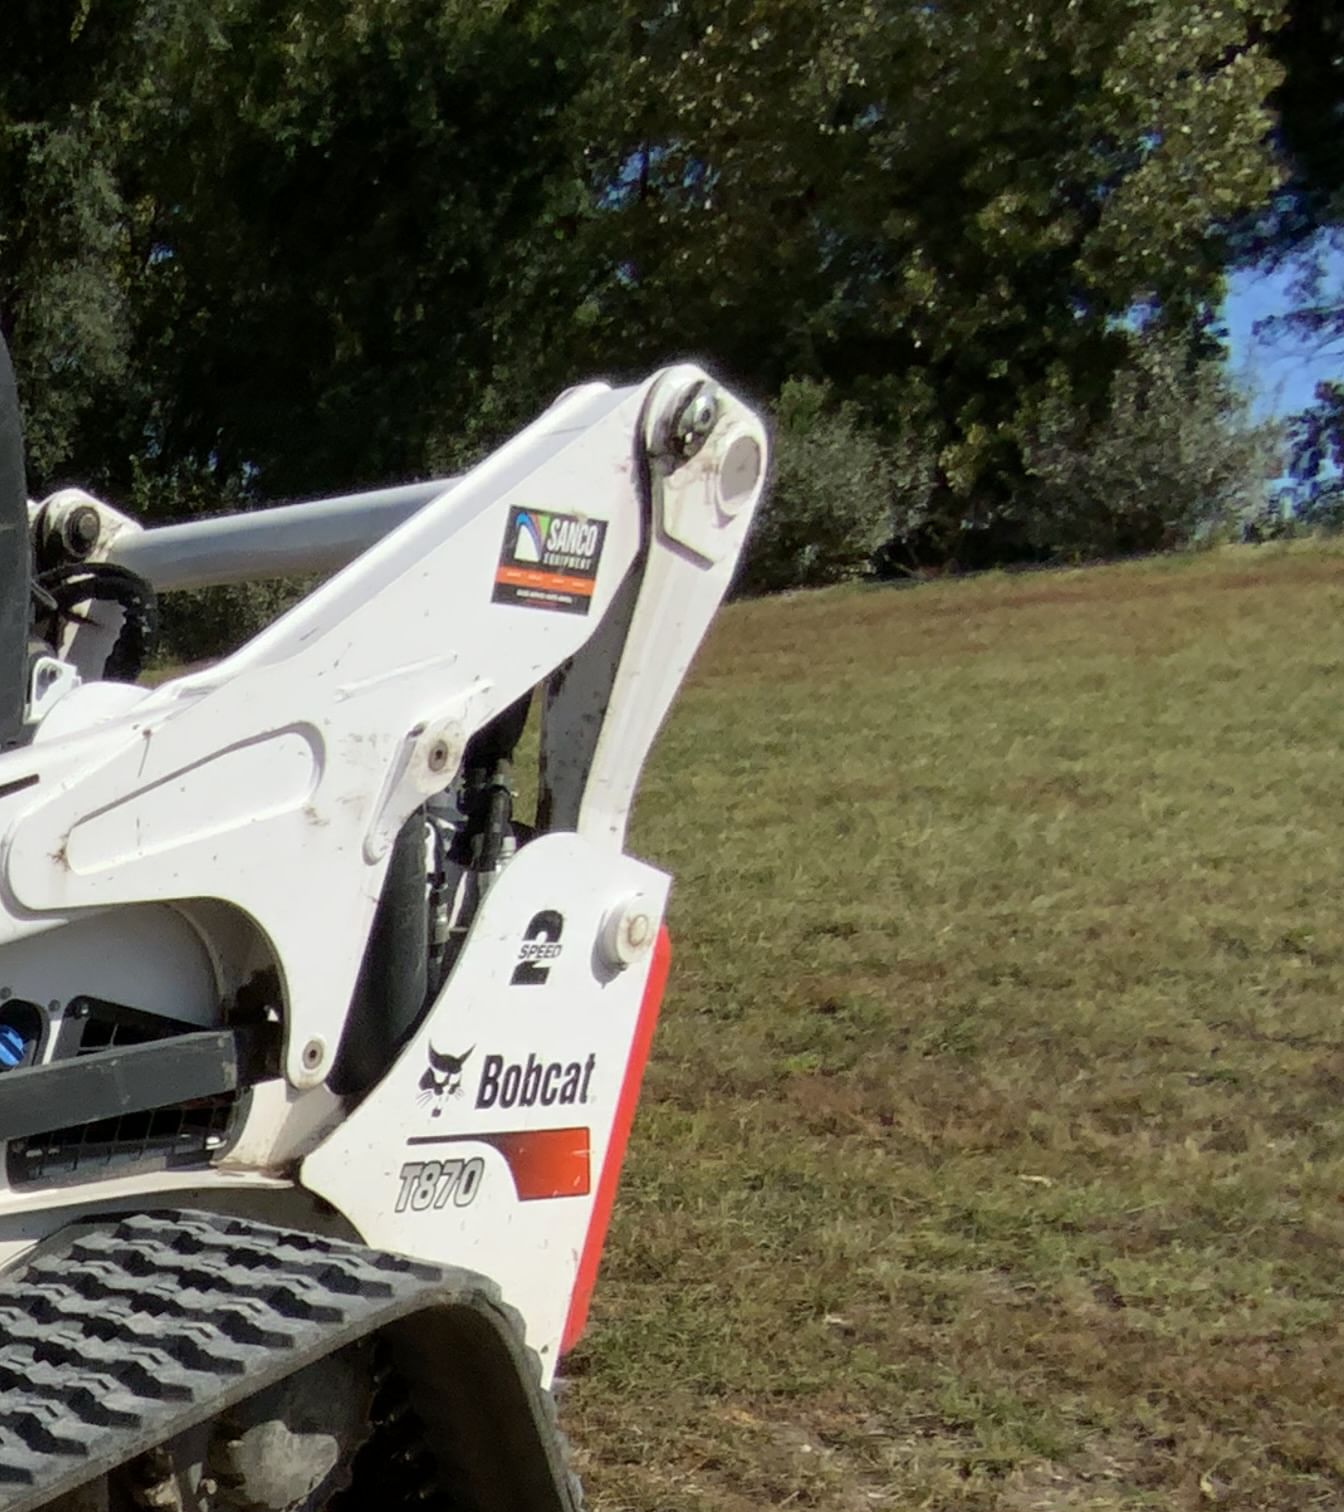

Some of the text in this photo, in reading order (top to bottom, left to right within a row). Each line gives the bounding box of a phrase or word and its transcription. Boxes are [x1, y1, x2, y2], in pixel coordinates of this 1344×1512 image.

[547, 518, 598, 556] SANCO
[509, 909, 564, 986] 2
[518, 944, 563, 959] SPEED
[475, 1053, 596, 1110] Bobcat
[395, 1157, 485, 1213] T870
